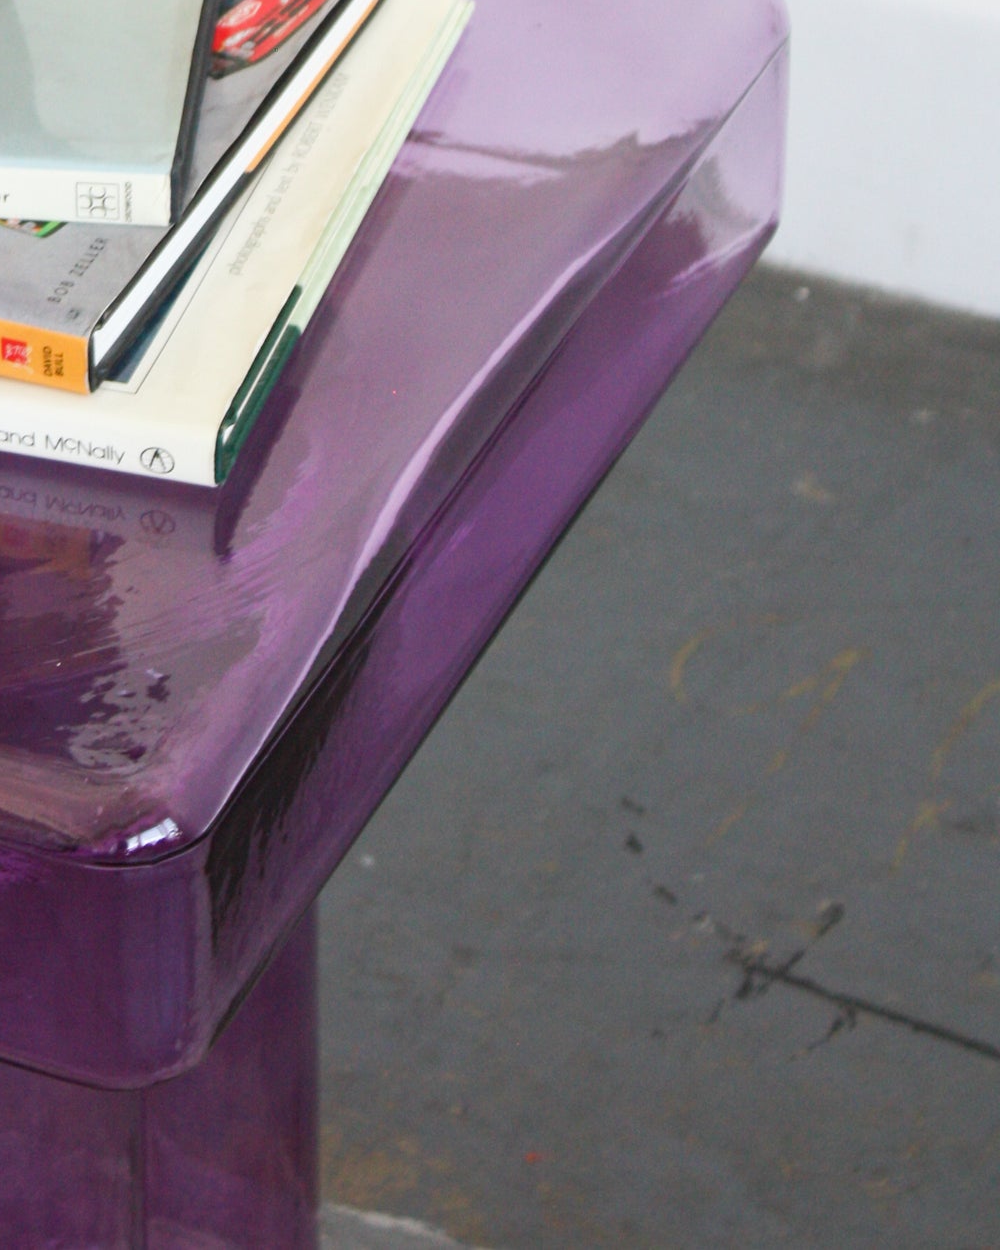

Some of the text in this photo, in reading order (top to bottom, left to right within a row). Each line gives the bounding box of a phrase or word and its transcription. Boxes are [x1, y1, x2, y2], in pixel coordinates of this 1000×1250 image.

[46, 279, 75, 304] BOB
[68, 235, 109, 278] ZELLER
[45, 434, 127, 466] McNally
